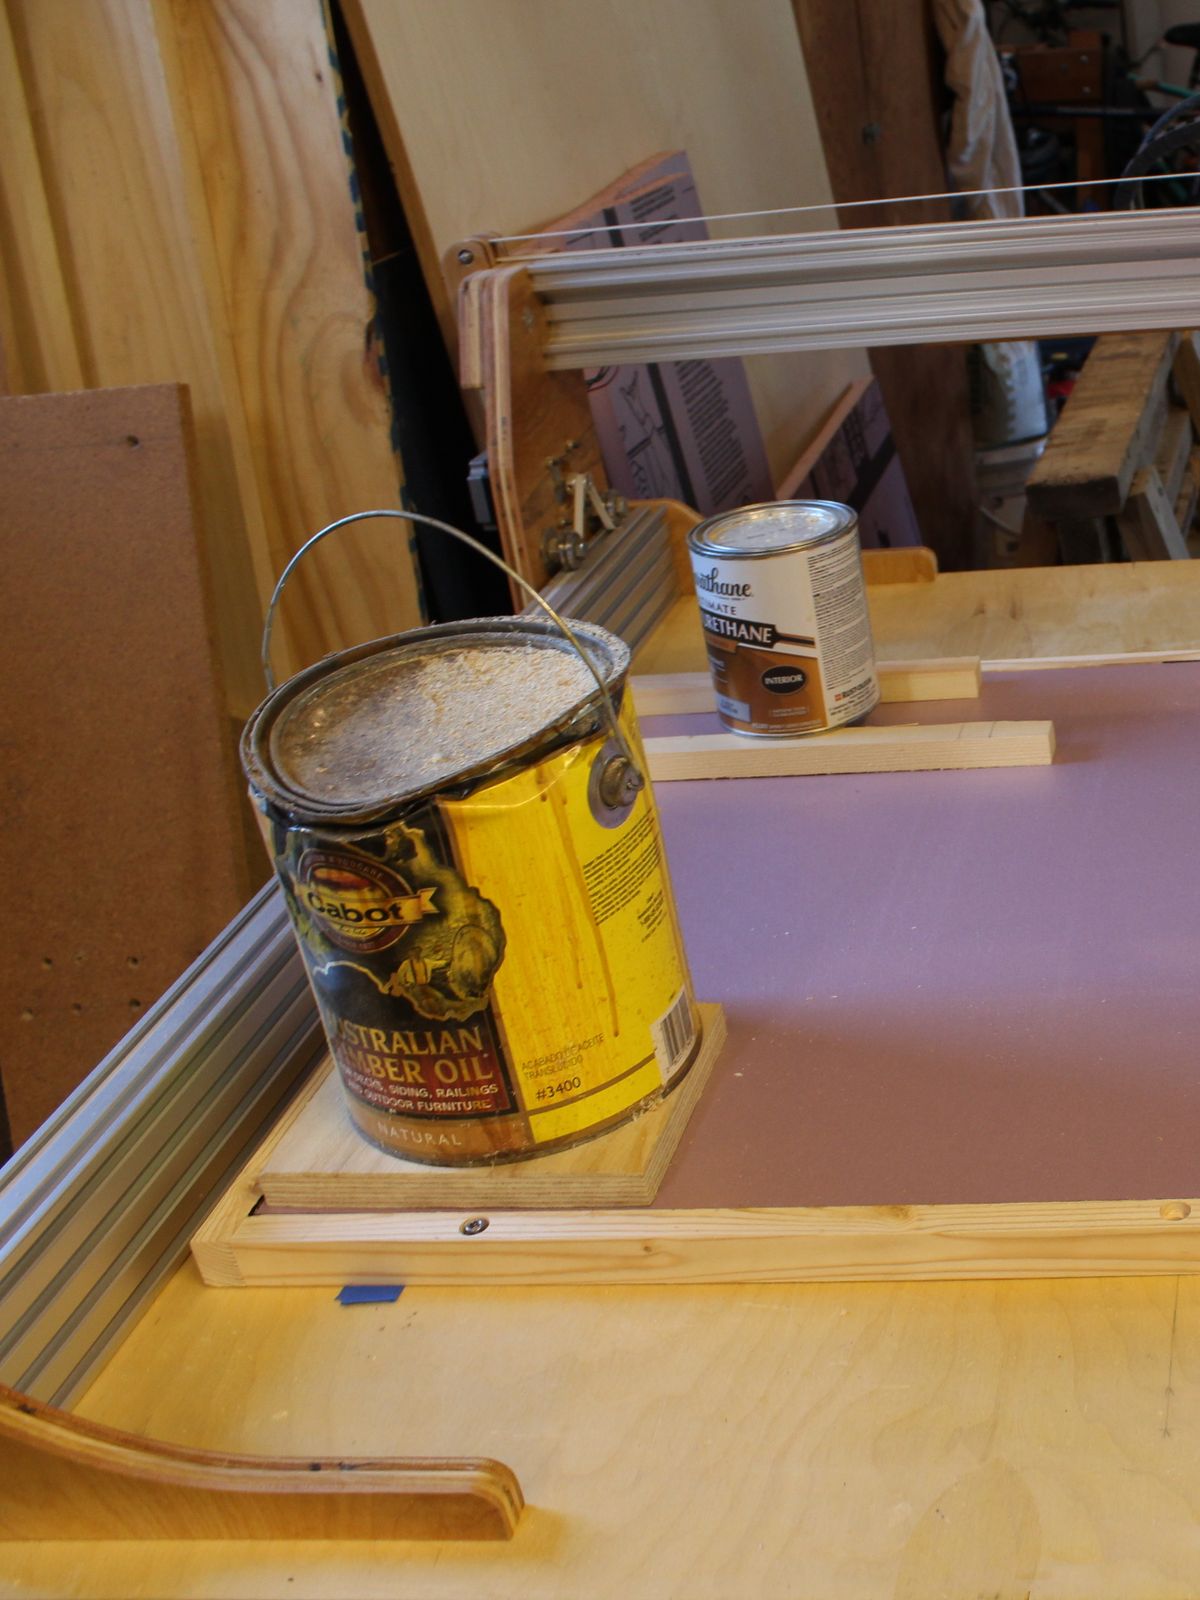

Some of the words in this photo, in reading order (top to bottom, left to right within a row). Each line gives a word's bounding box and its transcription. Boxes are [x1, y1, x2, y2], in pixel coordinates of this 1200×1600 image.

[764, 673, 804, 686] INTERIOR
[307, 891, 404, 923] Cabot
[433, 1055, 494, 1085] OIL
[436, 1083, 499, 1098] RAILINGS
[536, 1076, 582, 1102] #3400
[417, 1099, 492, 1112] FURNITURE
[376, 1121, 463, 1146] NATURAL
